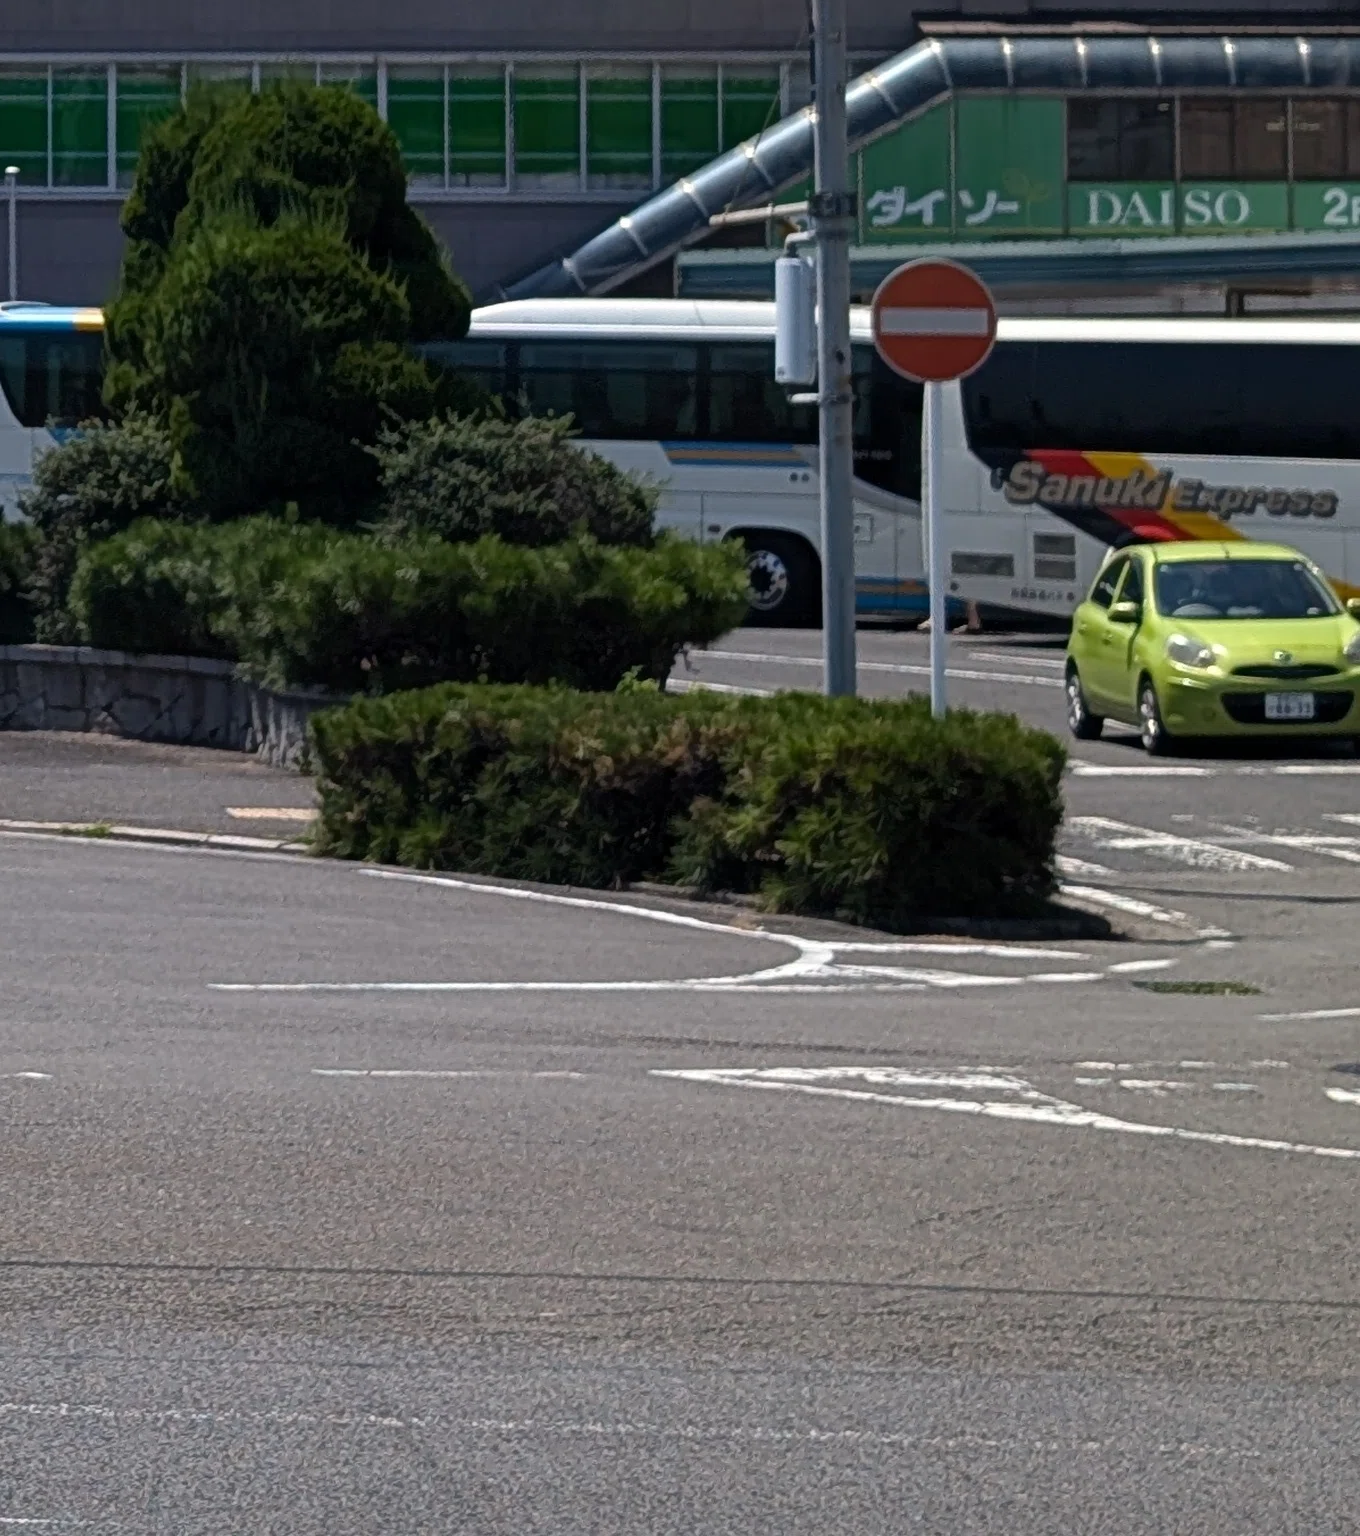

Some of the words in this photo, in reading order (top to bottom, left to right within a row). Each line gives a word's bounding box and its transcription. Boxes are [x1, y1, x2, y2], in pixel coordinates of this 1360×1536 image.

[866, 185, 1020, 227] ダイソー
[1088, 189, 1251, 227] DAISO
[1005, 460, 1174, 510] Sanuki
[1172, 477, 1340, 521] Express
